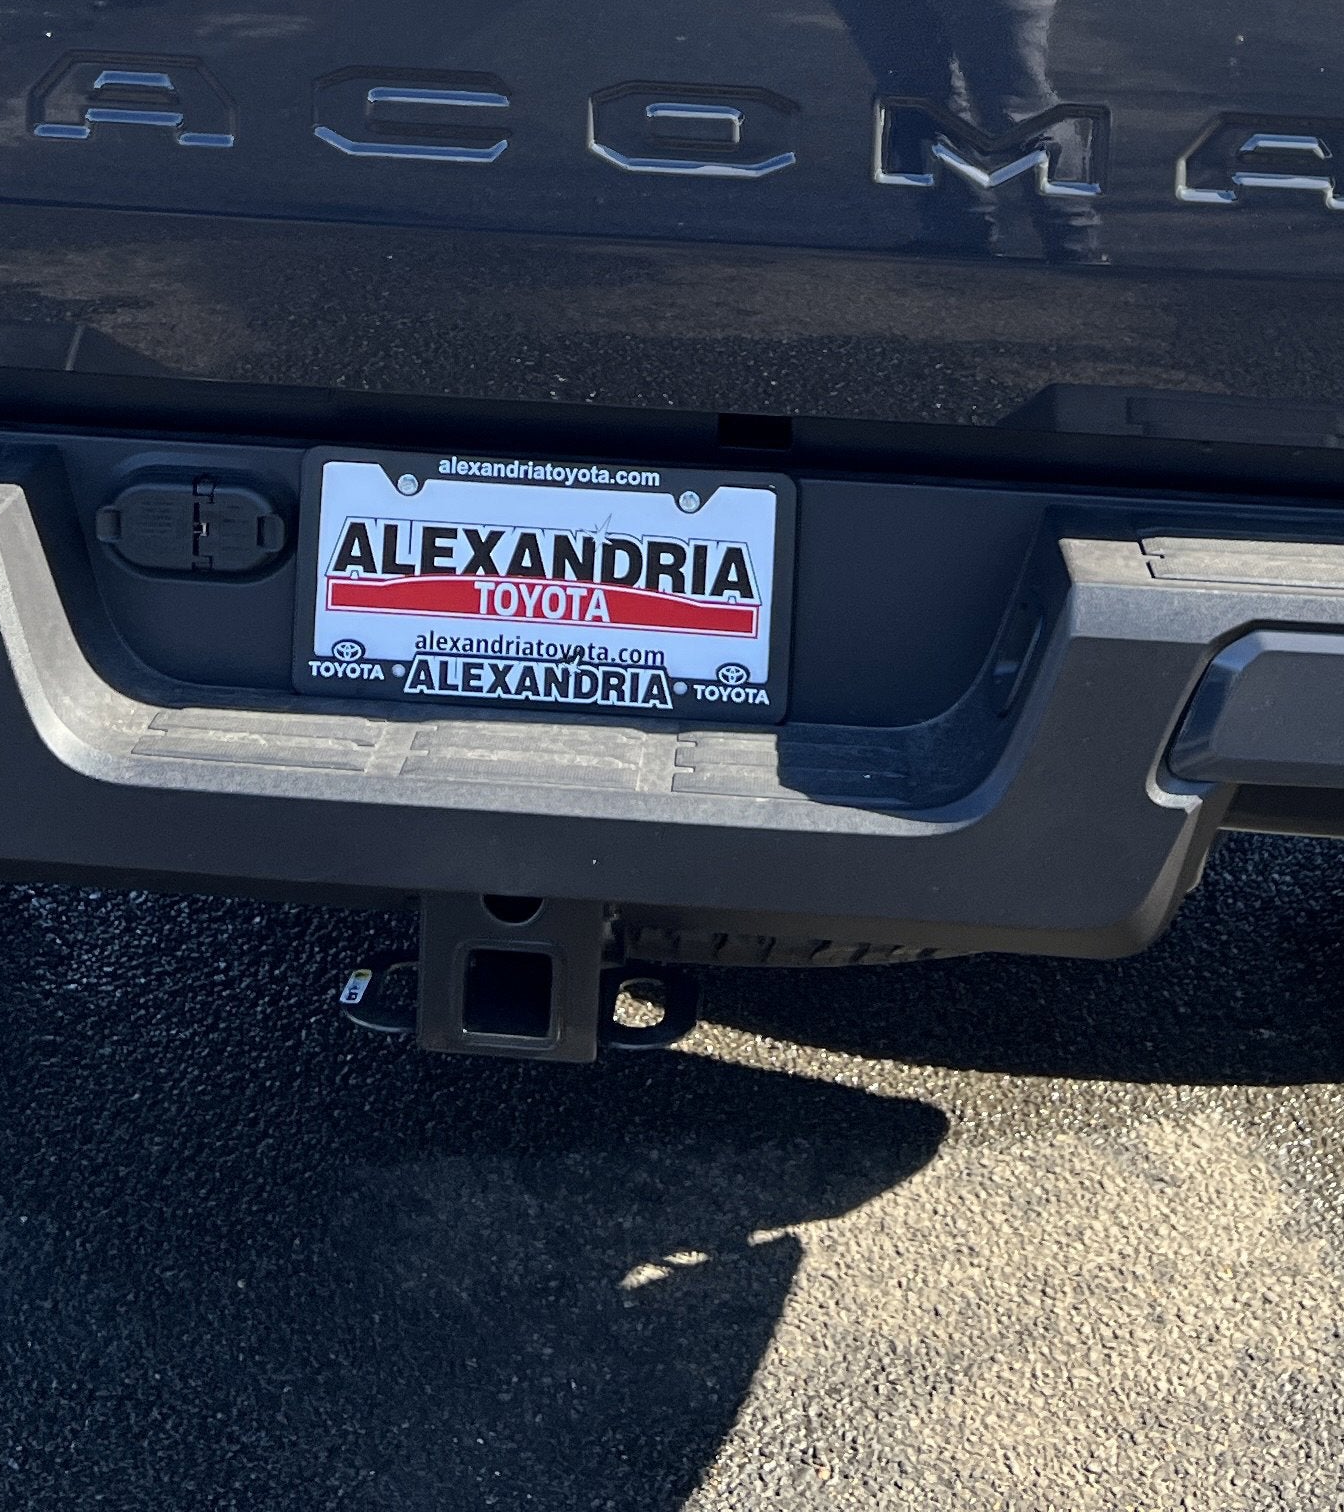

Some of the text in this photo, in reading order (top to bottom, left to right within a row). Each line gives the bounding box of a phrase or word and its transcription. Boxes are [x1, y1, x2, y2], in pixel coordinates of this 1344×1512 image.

[438, 456, 661, 487] alexandriatoyota.com
[333, 521, 757, 600] ALEXANDRIA
[473, 580, 612, 623] TOYOTA
[308, 659, 385, 682] TOYOTA
[406, 657, 672, 708] ALEXANDRIA
[693, 683, 771, 707] TOYOTA
